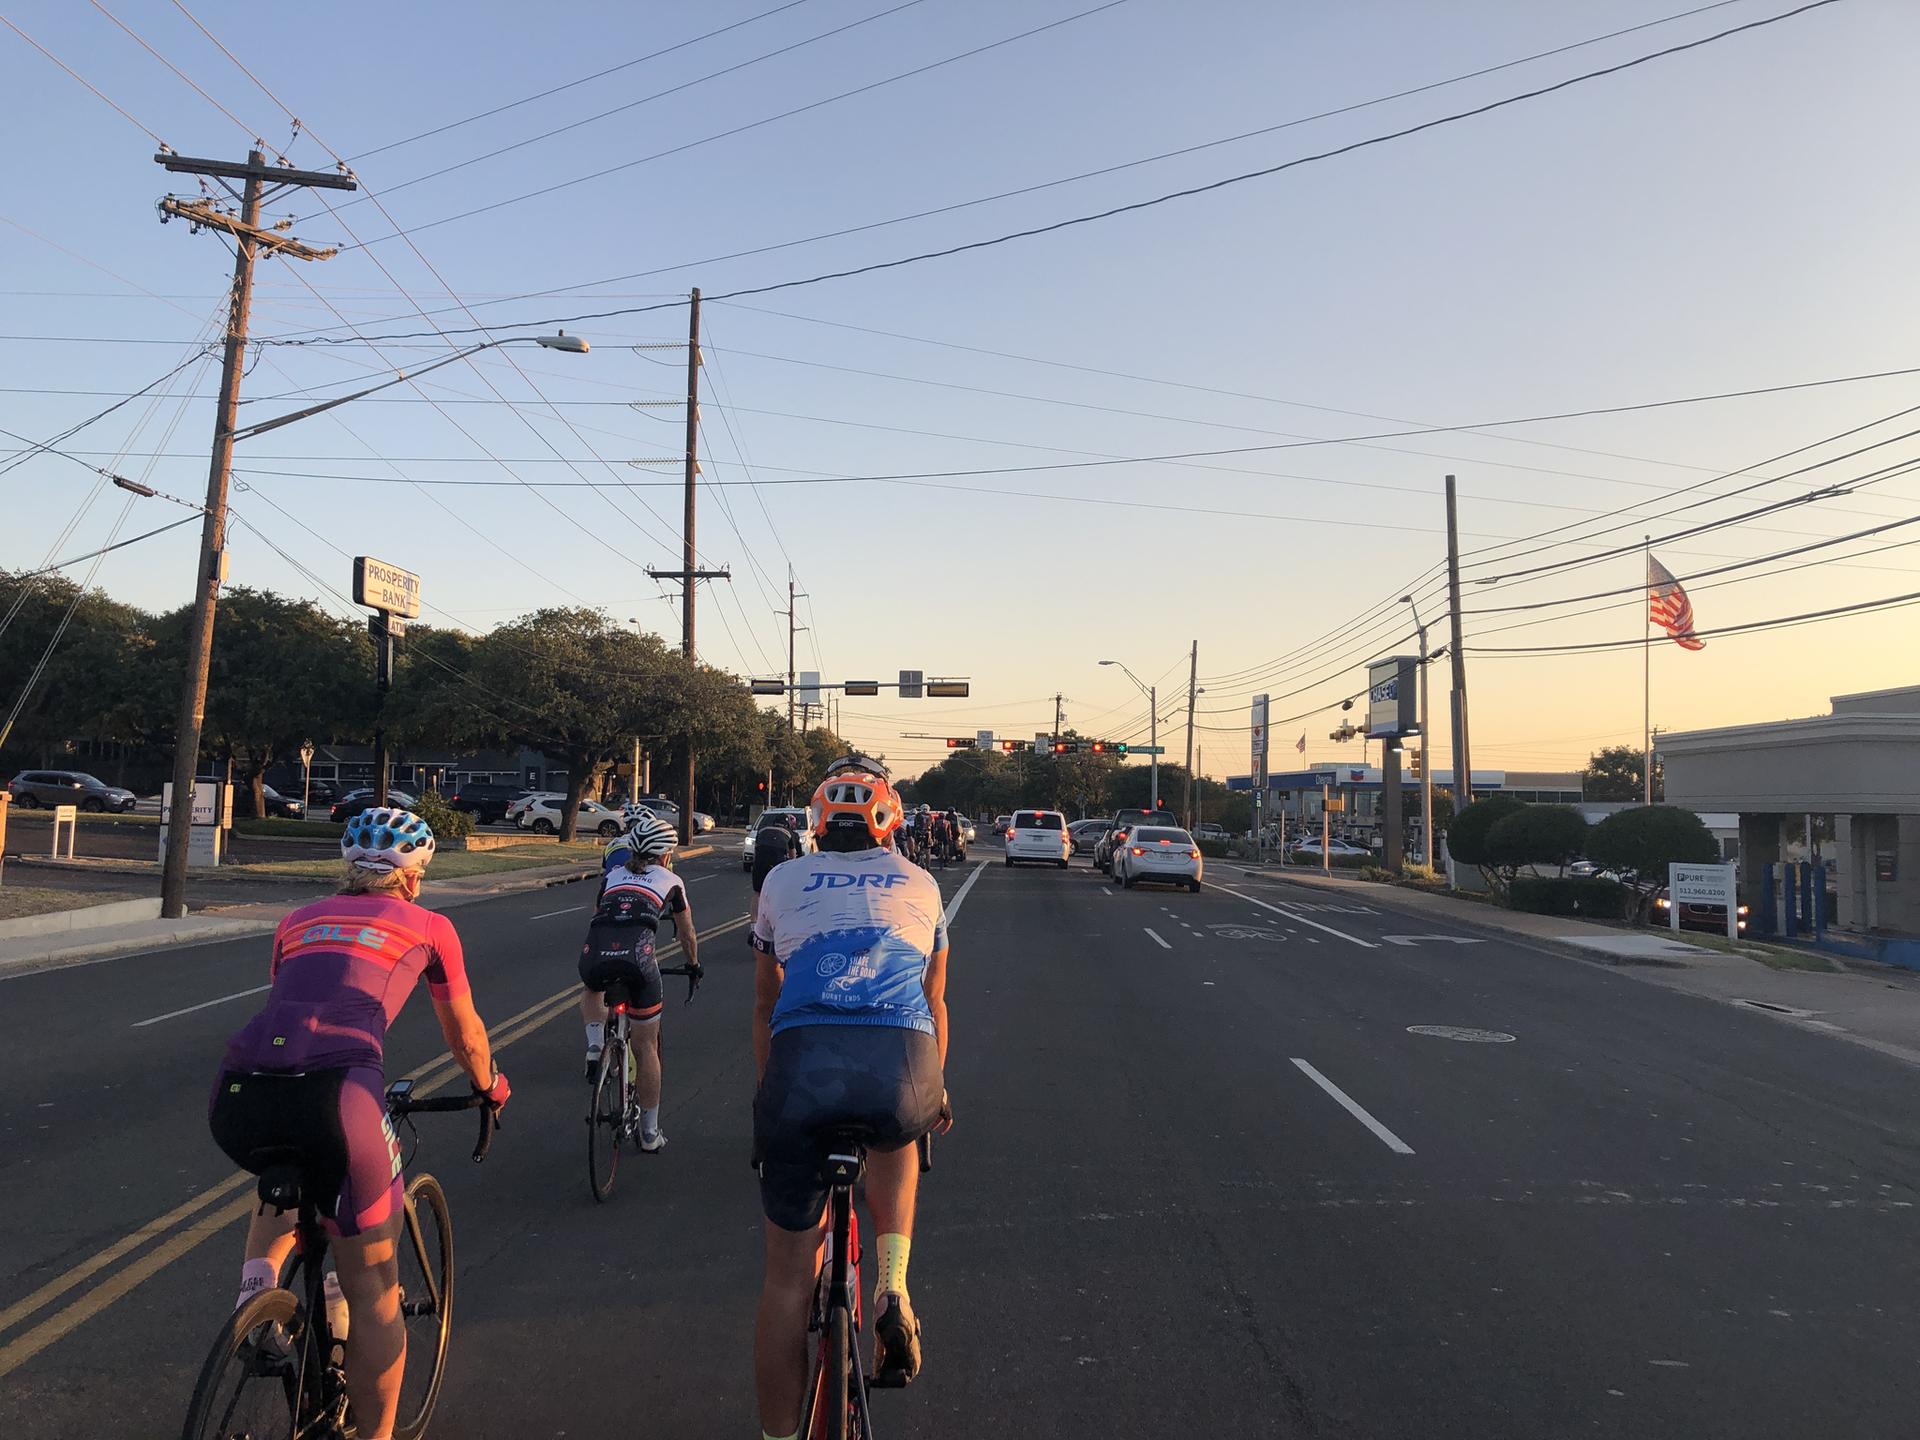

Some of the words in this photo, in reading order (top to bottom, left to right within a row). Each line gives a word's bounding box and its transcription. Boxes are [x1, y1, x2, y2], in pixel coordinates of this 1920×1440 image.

[368, 564, 419, 593] PROSPERITY
[382, 588, 406, 608] BANK
[803, 872, 910, 892] JDRF
[1684, 874, 1705, 882] PURE
[600, 949, 630, 957] TREK
